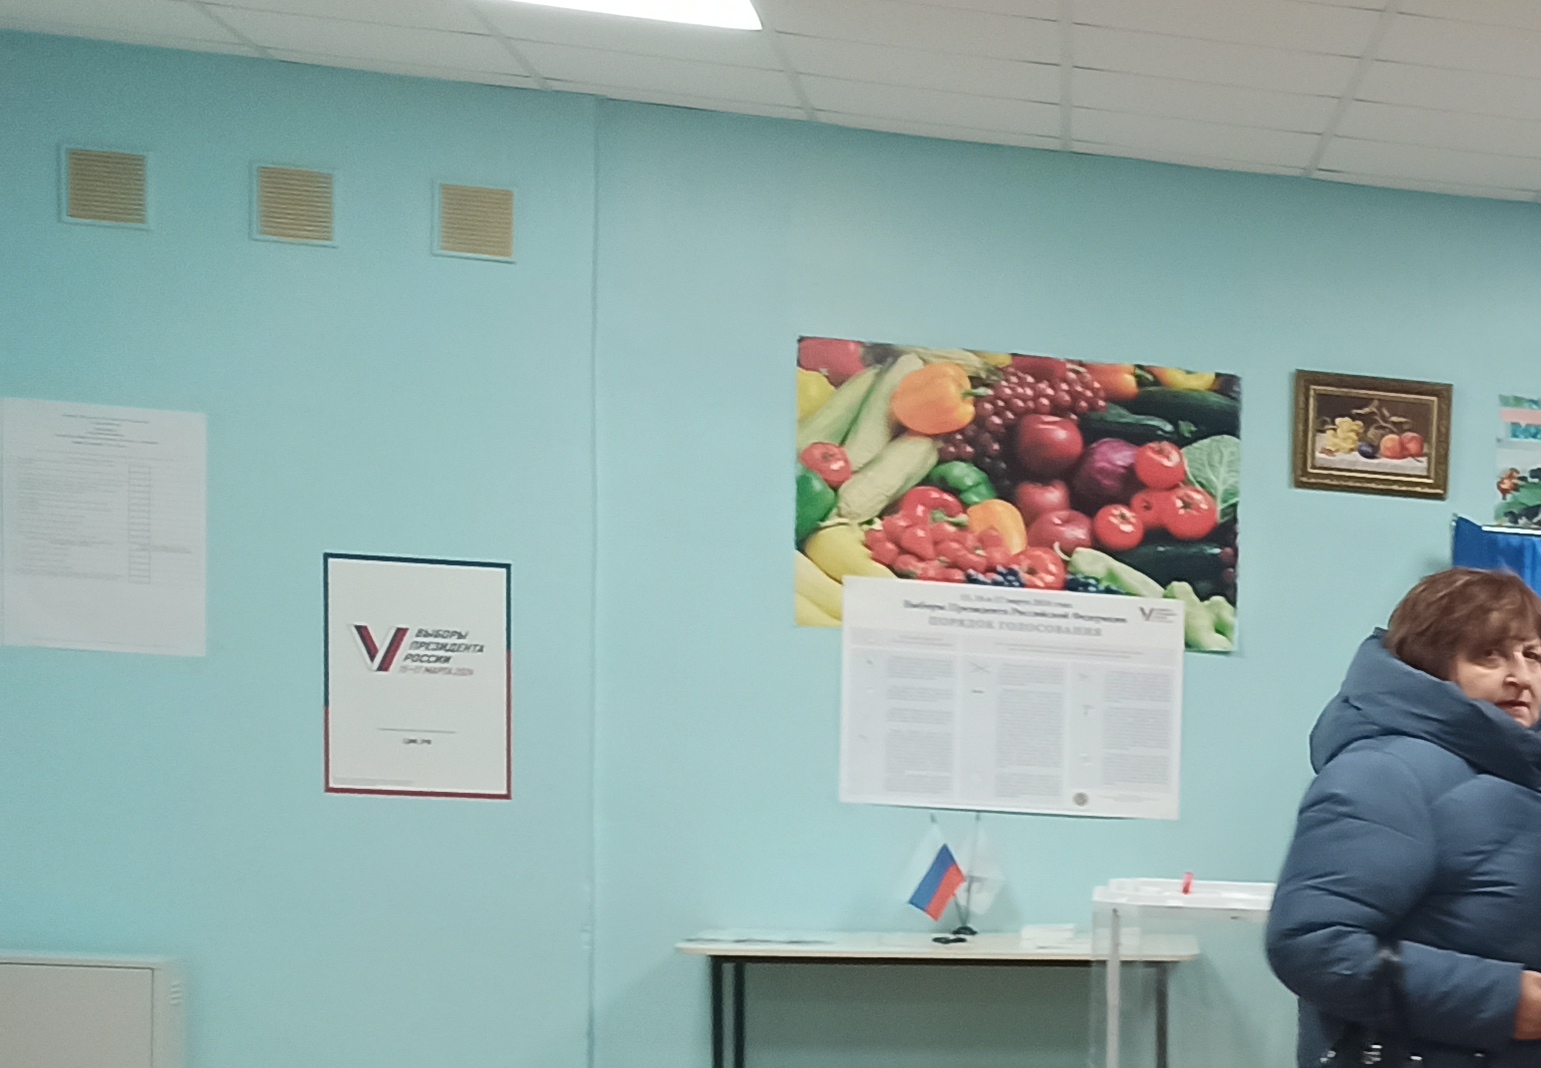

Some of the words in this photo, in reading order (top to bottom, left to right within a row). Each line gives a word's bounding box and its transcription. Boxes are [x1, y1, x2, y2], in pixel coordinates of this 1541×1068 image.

[415, 628, 469, 640] ВЫБОРЫ
[408, 640, 485, 653] ПРЕЗИДЕНТА
[403, 653, 451, 664] РОССИИ
